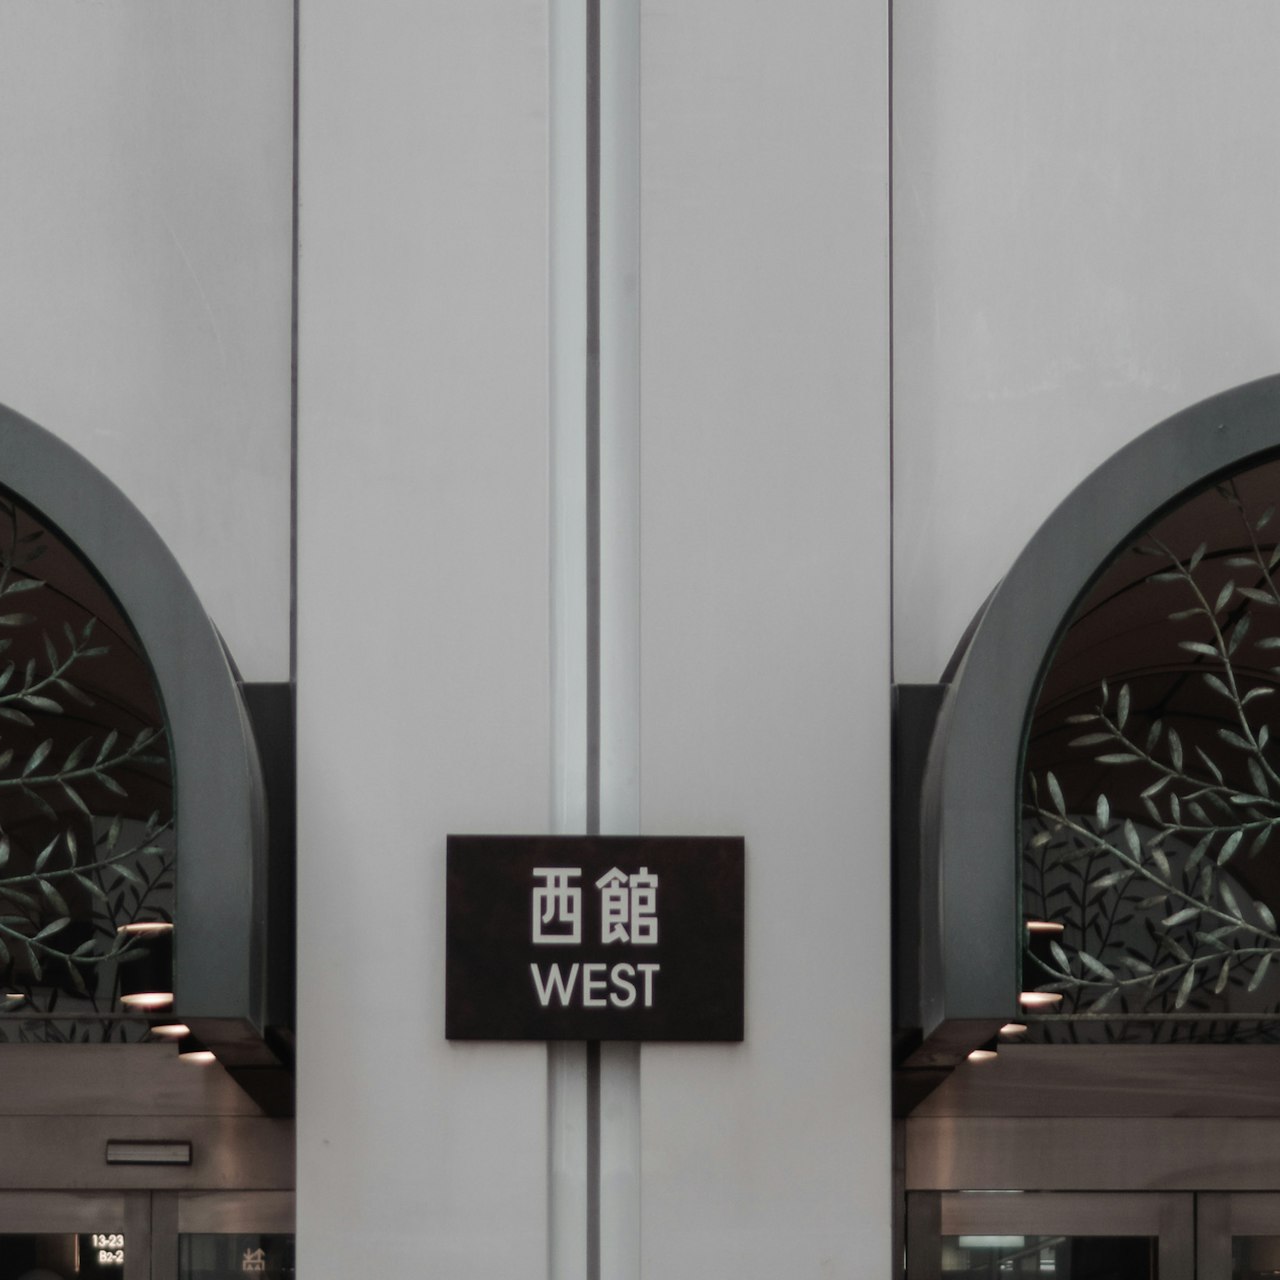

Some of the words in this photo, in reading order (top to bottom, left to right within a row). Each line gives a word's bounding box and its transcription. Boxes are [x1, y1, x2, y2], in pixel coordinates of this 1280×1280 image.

[532, 866, 659, 945] 西館
[530, 962, 661, 1008] WEST
[92, 1234, 124, 1248] 13-23
[99, 1249, 124, 1263] B2-2
